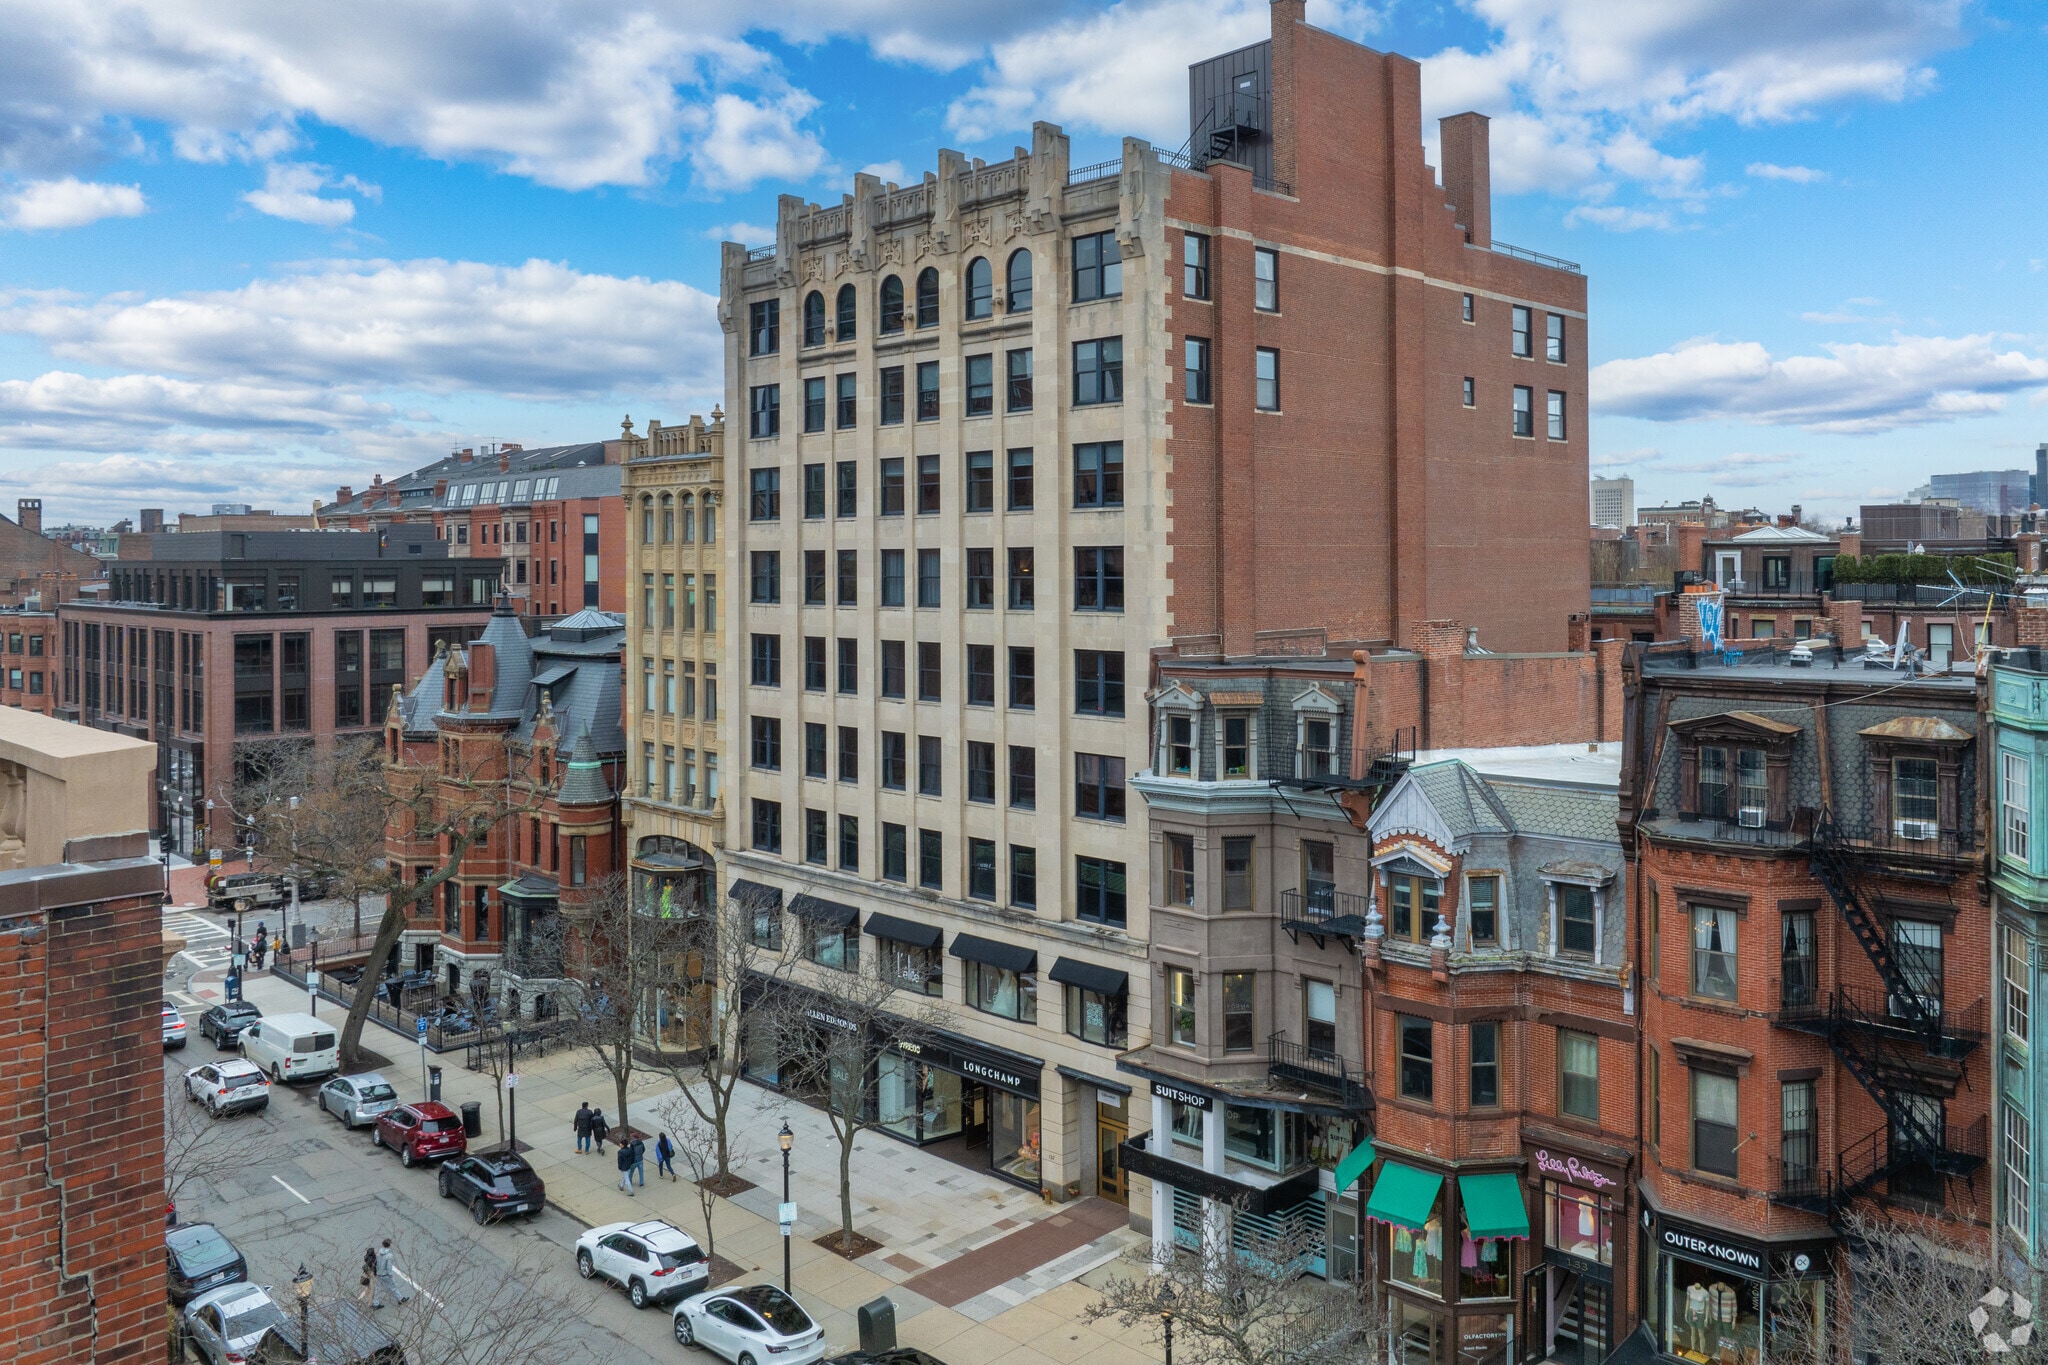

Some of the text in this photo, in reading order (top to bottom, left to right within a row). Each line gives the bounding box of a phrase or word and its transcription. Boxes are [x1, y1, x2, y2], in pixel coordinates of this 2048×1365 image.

[963, 1061, 1020, 1087] LONGCHAMP
[1155, 1084, 1205, 1107] SUITSHOP
[1535, 1149, 1617, 1188] Lilly Pulitzer
[1567, 1258, 1588, 1271] 133
